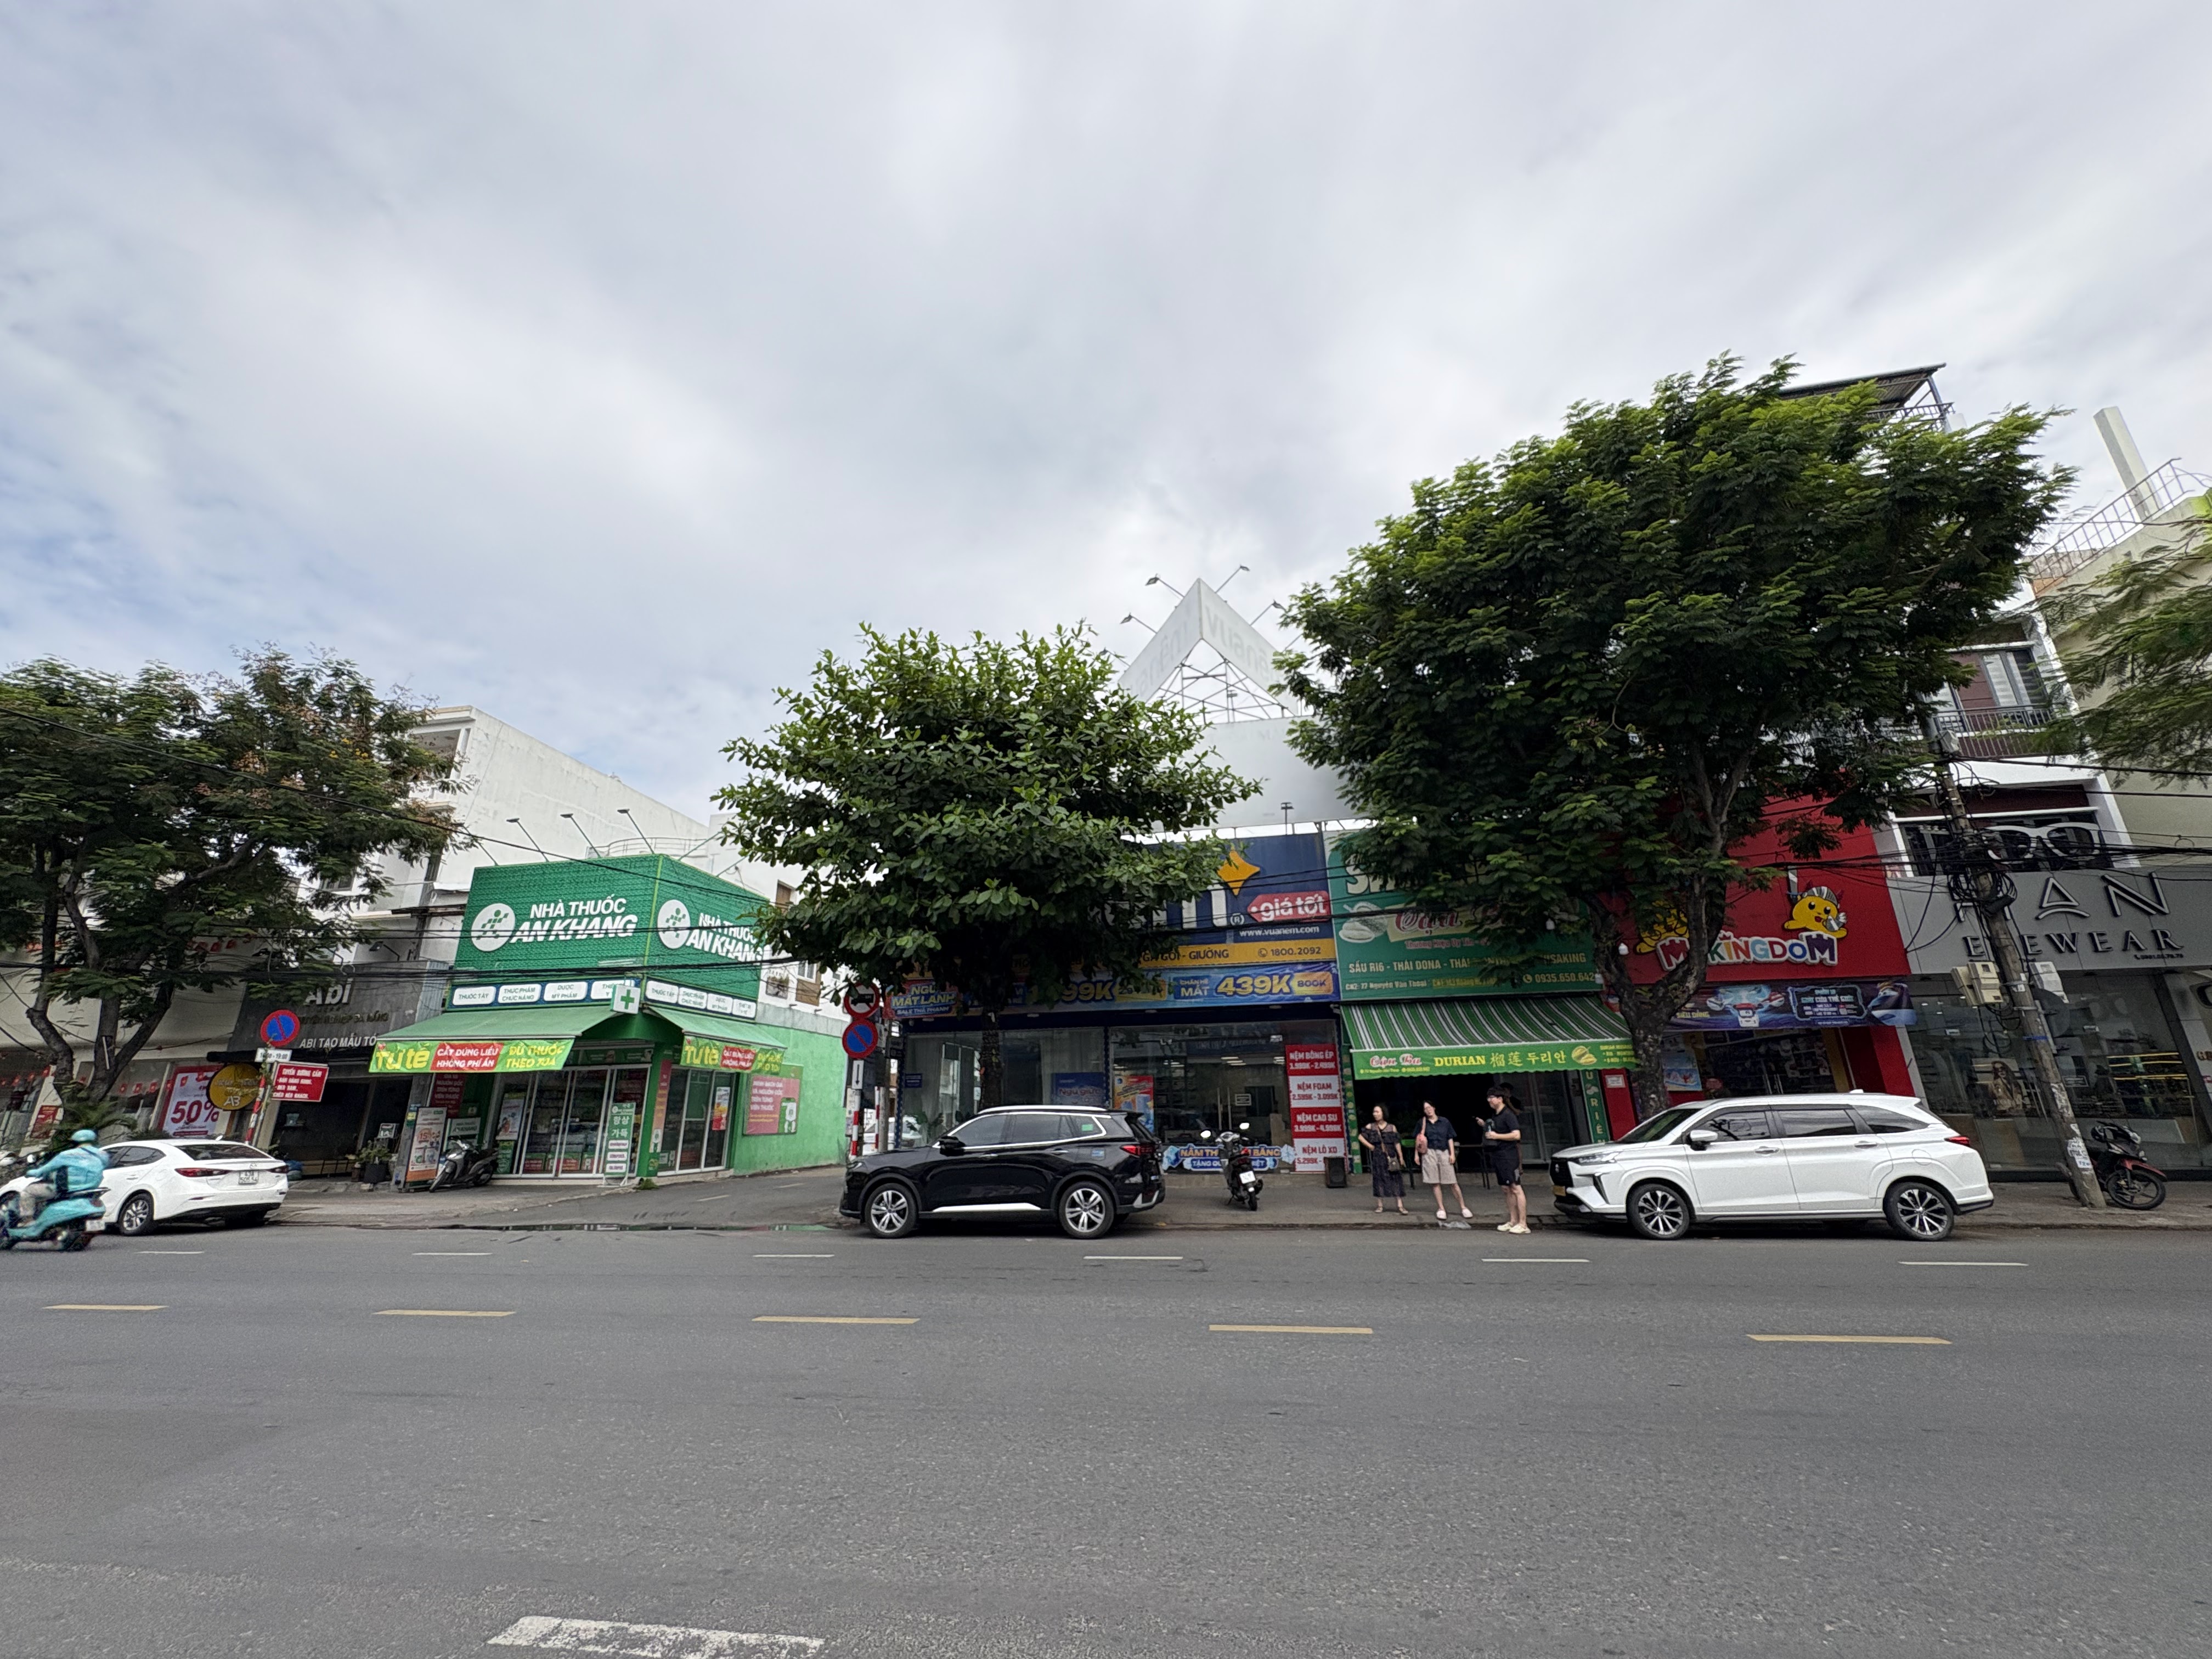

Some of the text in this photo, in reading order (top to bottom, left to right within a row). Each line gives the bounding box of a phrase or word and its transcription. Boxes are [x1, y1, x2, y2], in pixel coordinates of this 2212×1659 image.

[529, 894, 627, 919] NHÀ THUỐC
[1261, 893, 1327, 921] giá tốt
[509, 914, 639, 944] AN KHANG
[686, 929, 713, 953] AN
[1271, 947, 1321, 956] 1800.2092
[1965, 928, 2184, 956] EEWEAR
[1189, 947, 1229, 960] GIƯỜNG
[1216, 974, 1291, 996] 439K
[299, 1037, 317, 1048] ABI
[1434, 1054, 1486, 1066] DURIAN
[1491, 1051, 1523, 1068] 榴莲
[1527, 1050, 1567, 1065] 두리안
[171, 1099, 219, 1124] 50%
